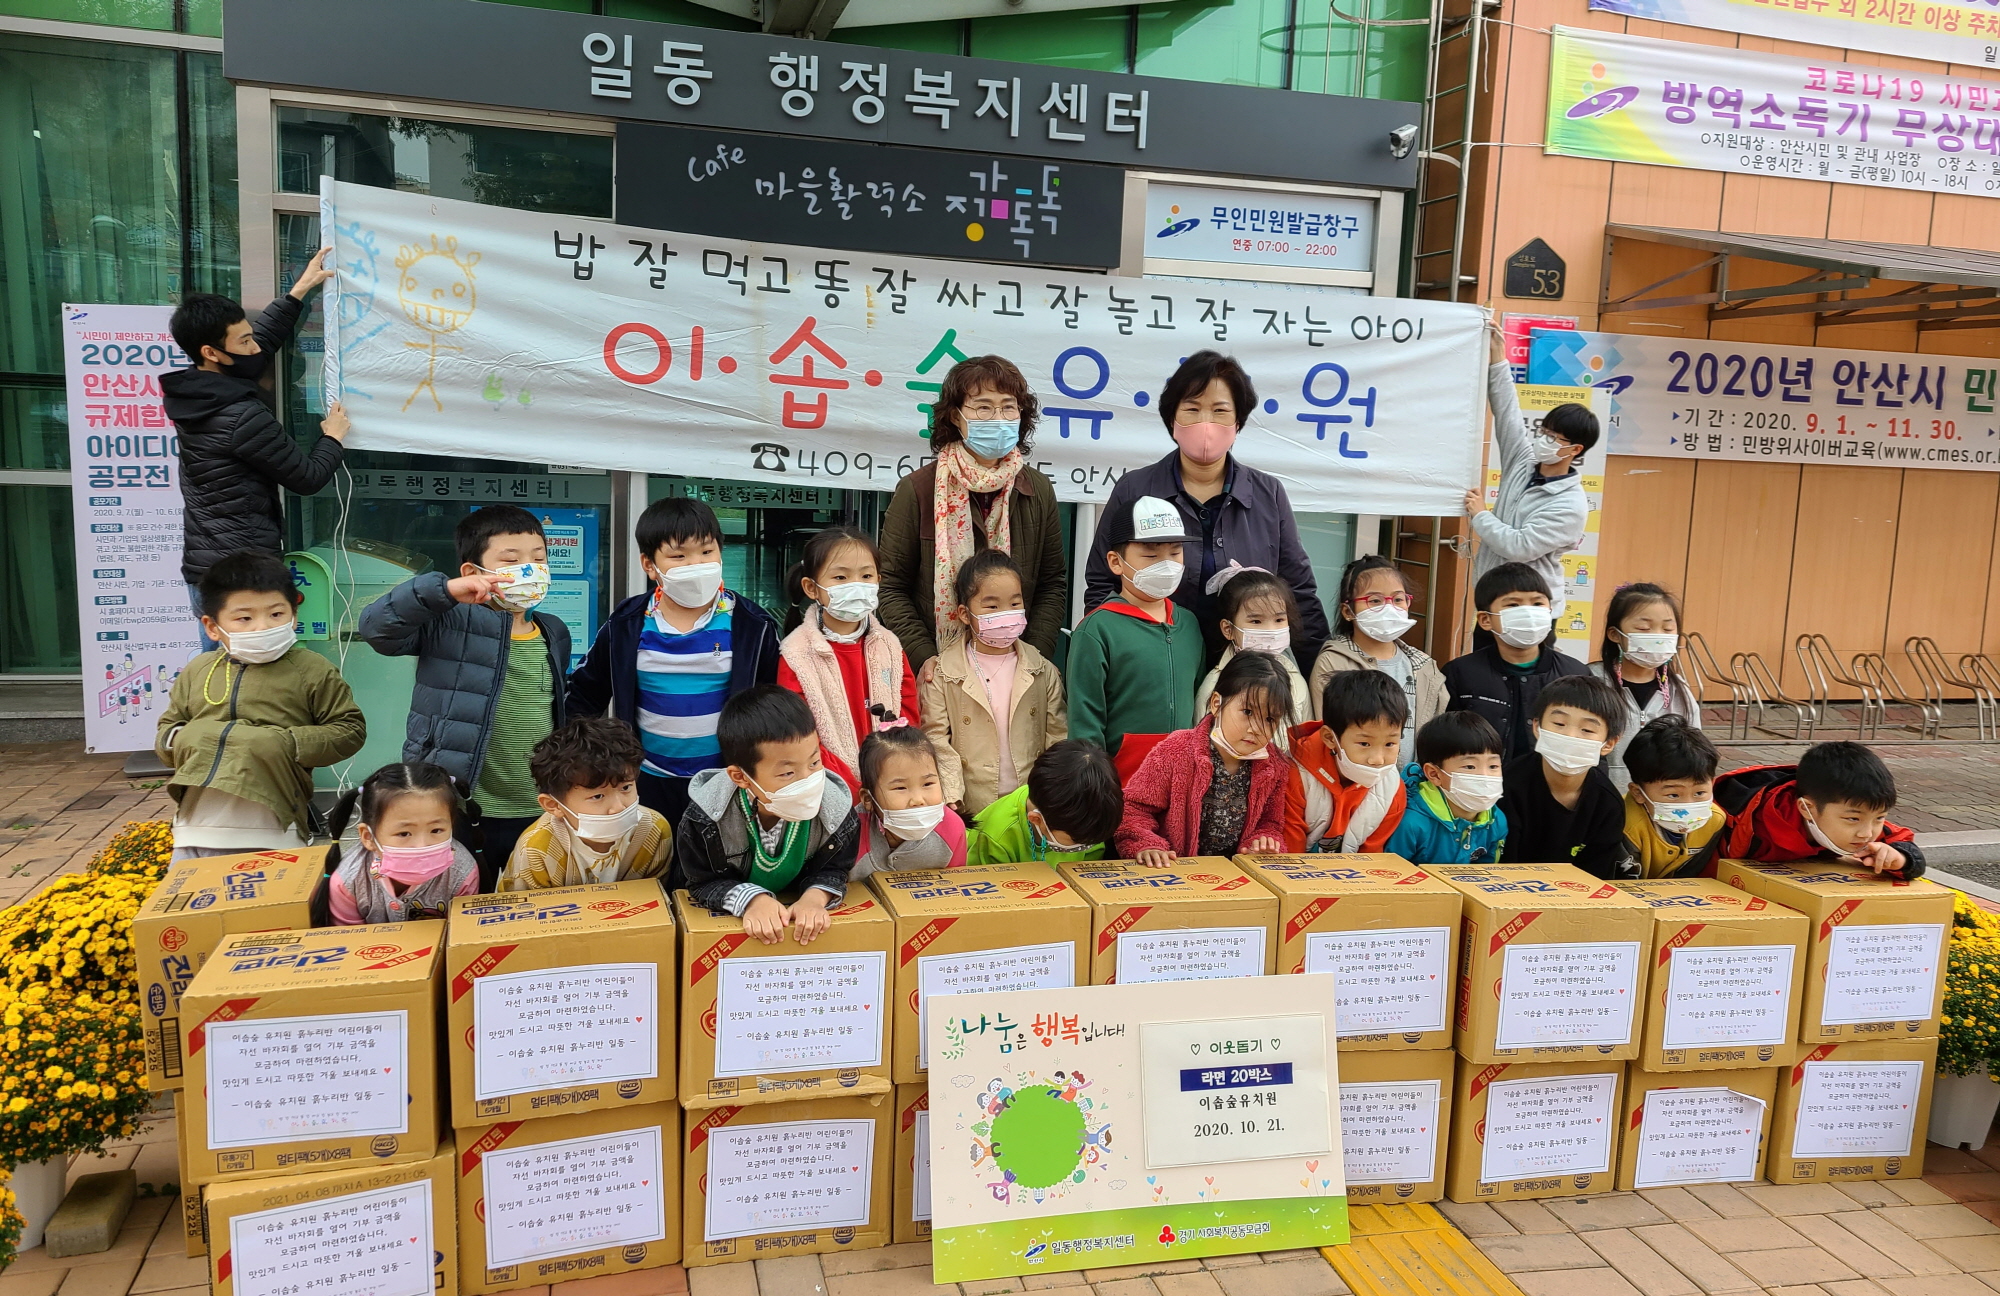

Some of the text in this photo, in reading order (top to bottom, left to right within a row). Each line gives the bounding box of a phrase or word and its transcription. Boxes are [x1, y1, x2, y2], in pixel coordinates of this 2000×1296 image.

[1865, 0, 1916, 25] 2시간
[1924, 6, 1961, 32] 이상
[581, 33, 1150, 150] 일동 행정복지센터
[1803, 66, 1925, 102] 코로나19
[1661, 80, 1872, 143] 방역소독기
[688, 143, 747, 182] Cafe
[1780, 139, 1830, 155] 안산시민
[1837, 144, 1848, 160] 및
[1854, 147, 1879, 164] 관내
[1884, 150, 1921, 168] 사업장
[1818, 161, 1830, 177] 월
[1849, 165, 1896, 183] 금(평일)
[1902, 170, 1926, 186] 10시
[1945, 174, 1968, 190] 18시
[755, 168, 927, 222] 마을활력소
[1210, 207, 1360, 239] 무인민원발급창구
[1232, 239, 1337, 256] 연중 07:00 22:00
[554, 230, 1424, 347] 밥 잘 먹고 똥 잘 싸고 잘 놀고 잘 자는 아이
[1531, 269, 1560, 295] 53
[115, 332, 154, 341] 제안하고
[82, 344, 191, 367] 2020년
[1666, 350, 1998, 413] 2020년 안산시 민
[85, 404, 175, 428] 규제합
[1743, 411, 1797, 432] 2020.
[1807, 414, 1825, 435] 9.
[1837, 415, 1855, 436] 1.
[1888, 418, 1919, 439] 11.
[1930, 420, 1962, 441] 30.
[88, 465, 170, 488] 공모전
[98, 581, 112, 589] 안산
[701, 940, 732, 969] 멀티팩
[462, 951, 498, 985] 멀티팩
[740, 970, 763, 979] 이솝숲
[768, 968, 790, 977] 유치원
[828, 964, 865, 974] 어린이들이
[745, 977, 859, 991] 자선 바자회를 열어 기부 금액을
[757, 991, 846, 1004] 모금하여 마련하였습니다.
[729, 1004, 858, 1020] 맛있게 드시고 따뜻한 겨울 보내세요
[747, 1031, 771, 1041] 이솝숲
[775, 1030, 799, 1039] 유치원
[838, 1026, 854, 1035] 일동
[960, 1012, 1126, 1054] 나눔은 행복입니다!
[1209, 1038, 1264, 1055] 이웃돕기
[1201, 1067, 1273, 1085] 라면 20박스
[1199, 1091, 1278, 1111] 이솝숲유치원
[1194, 1118, 1285, 1138] 2020. 10. 21.
[1179, 1222, 1270, 1243] 경기 사회복지공동모금회
[1051, 1235, 1135, 1255] 일동행정복지센터
